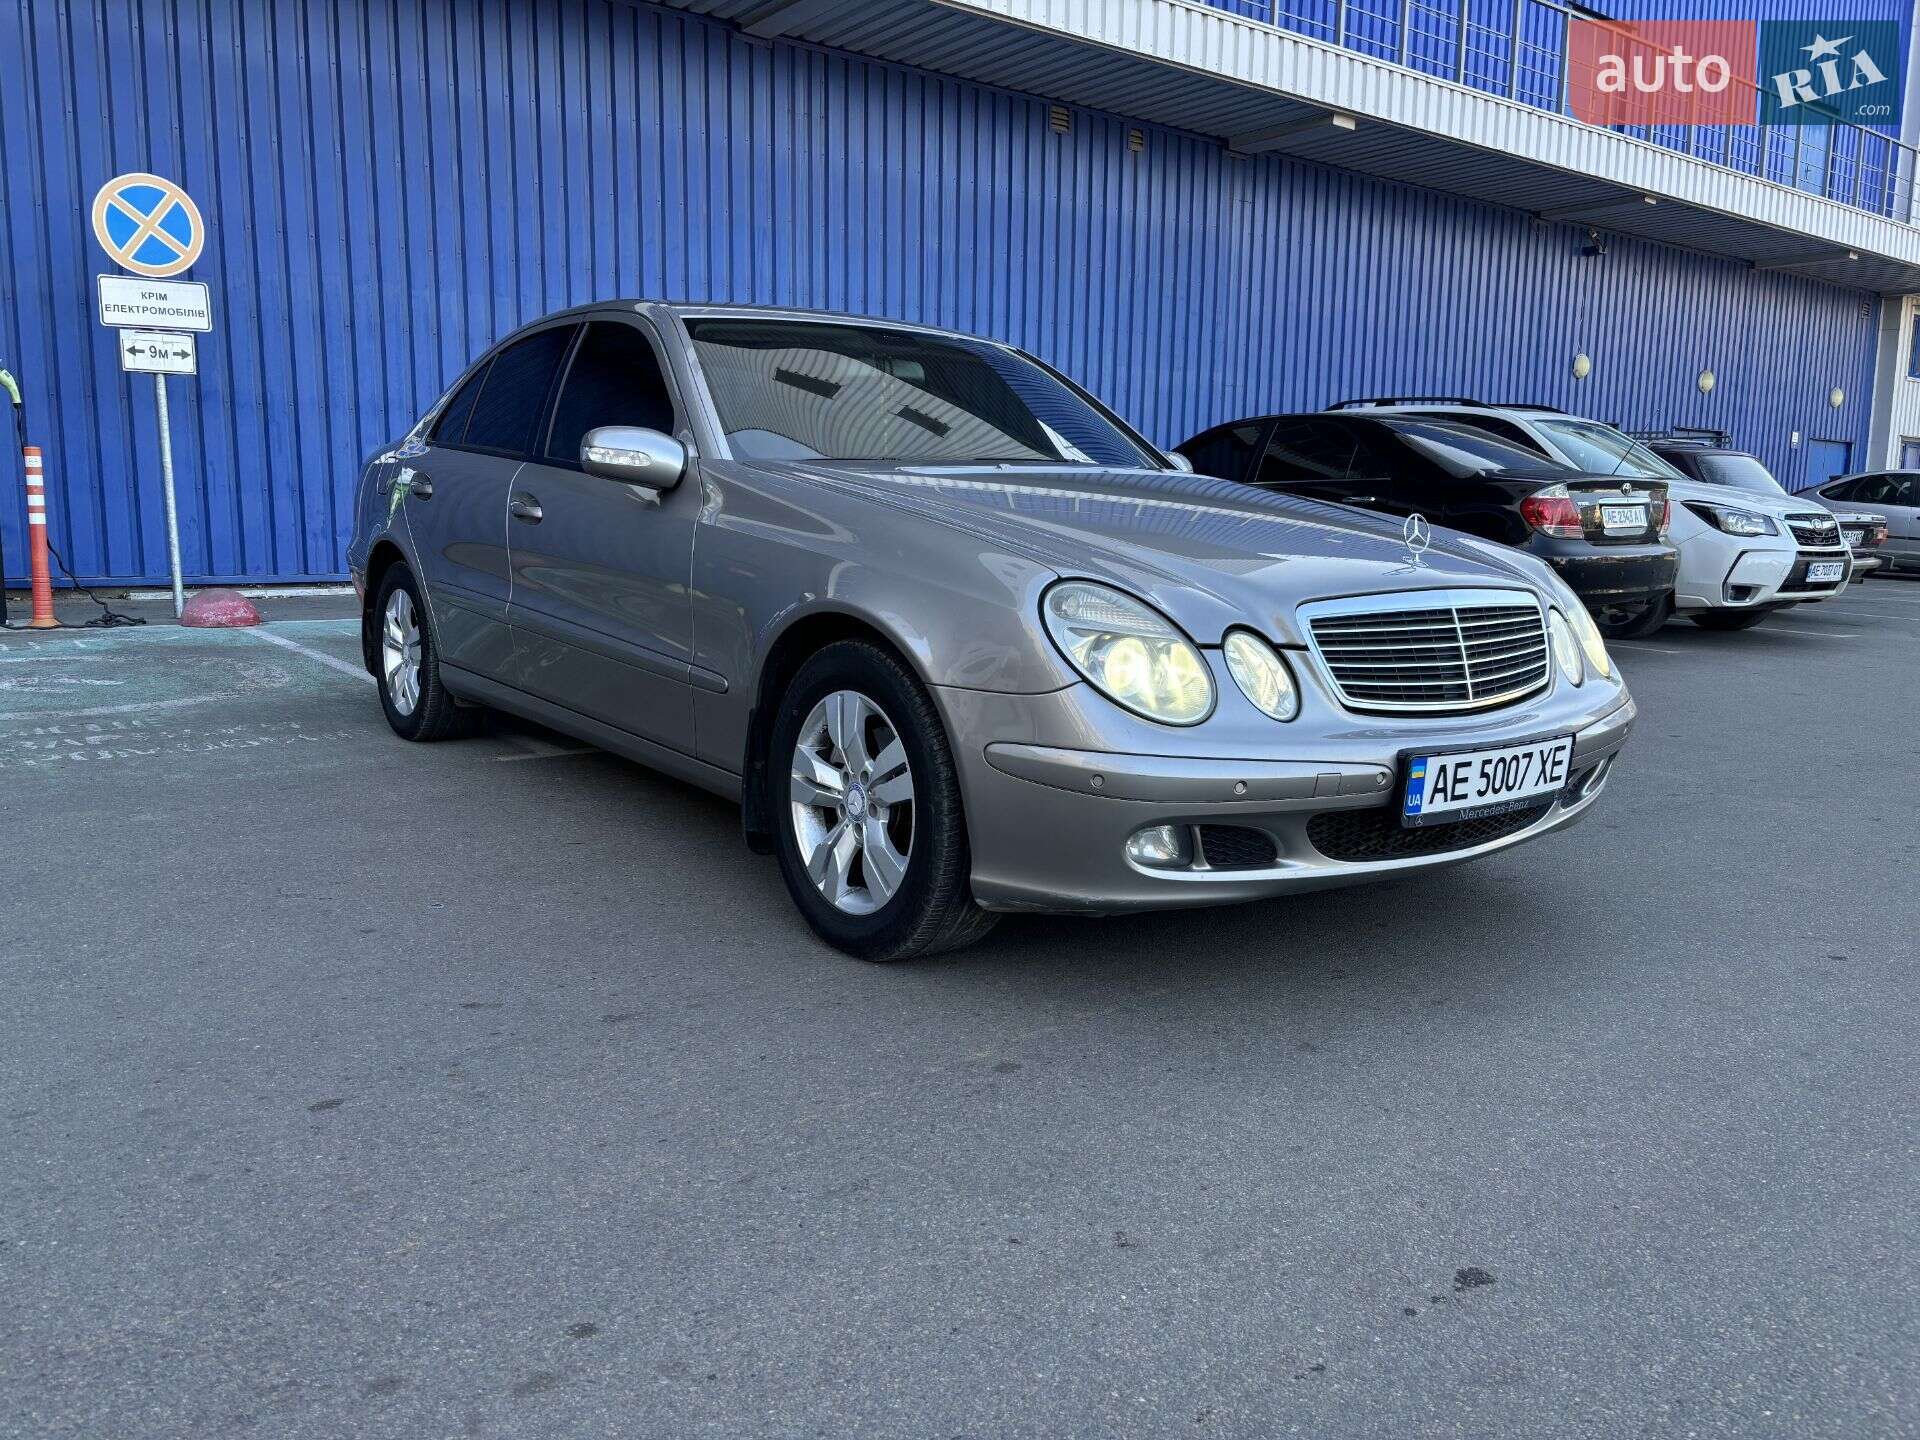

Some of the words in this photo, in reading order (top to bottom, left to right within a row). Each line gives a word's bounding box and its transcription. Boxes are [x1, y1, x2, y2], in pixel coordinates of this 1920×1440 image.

[141, 292, 168, 301] КРІМ
[104, 304, 205, 318] ЕЛЕКТРОМОБІЛІВ
[1607, 510, 1618, 524] AE
[1428, 760, 1473, 805] AE
[1476, 752, 1534, 798] 5007
[1534, 744, 1567, 787] XE
[1408, 793, 1421, 807] UA
[1458, 799, 1529, 821] Mercedes-Benz
